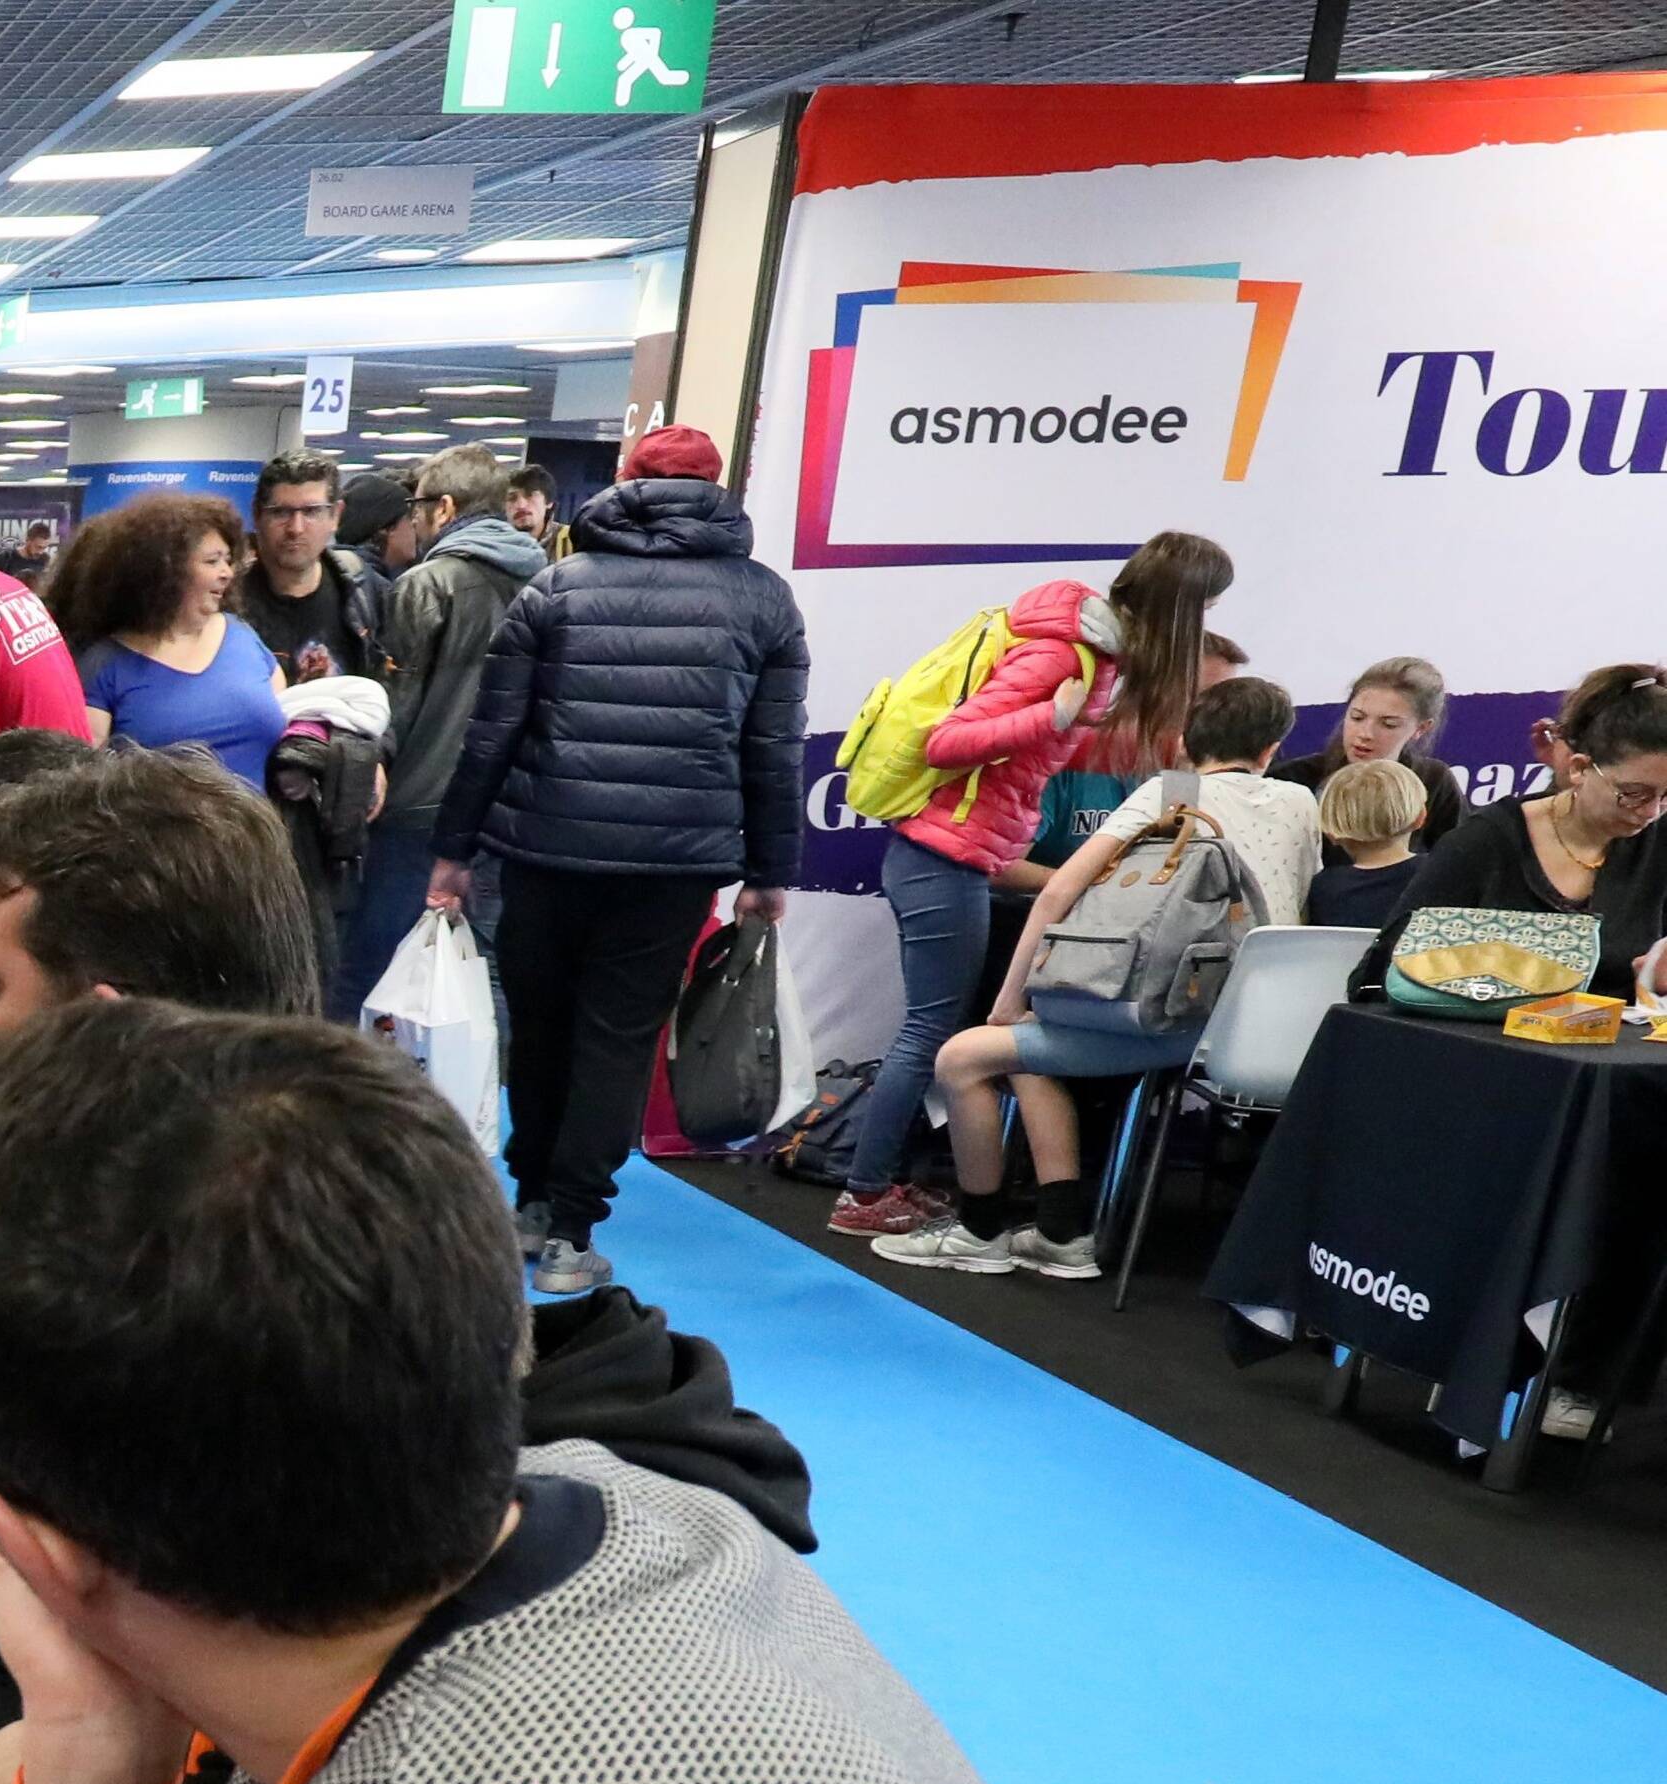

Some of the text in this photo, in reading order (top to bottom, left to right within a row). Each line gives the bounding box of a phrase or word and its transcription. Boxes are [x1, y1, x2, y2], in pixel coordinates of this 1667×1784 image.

[323, 204, 455, 218] BOARD GAME ARENA
[310, 378, 345, 414] 25
[890, 394, 1188, 445] asmodee
[107, 471, 188, 485] Ravensburger
